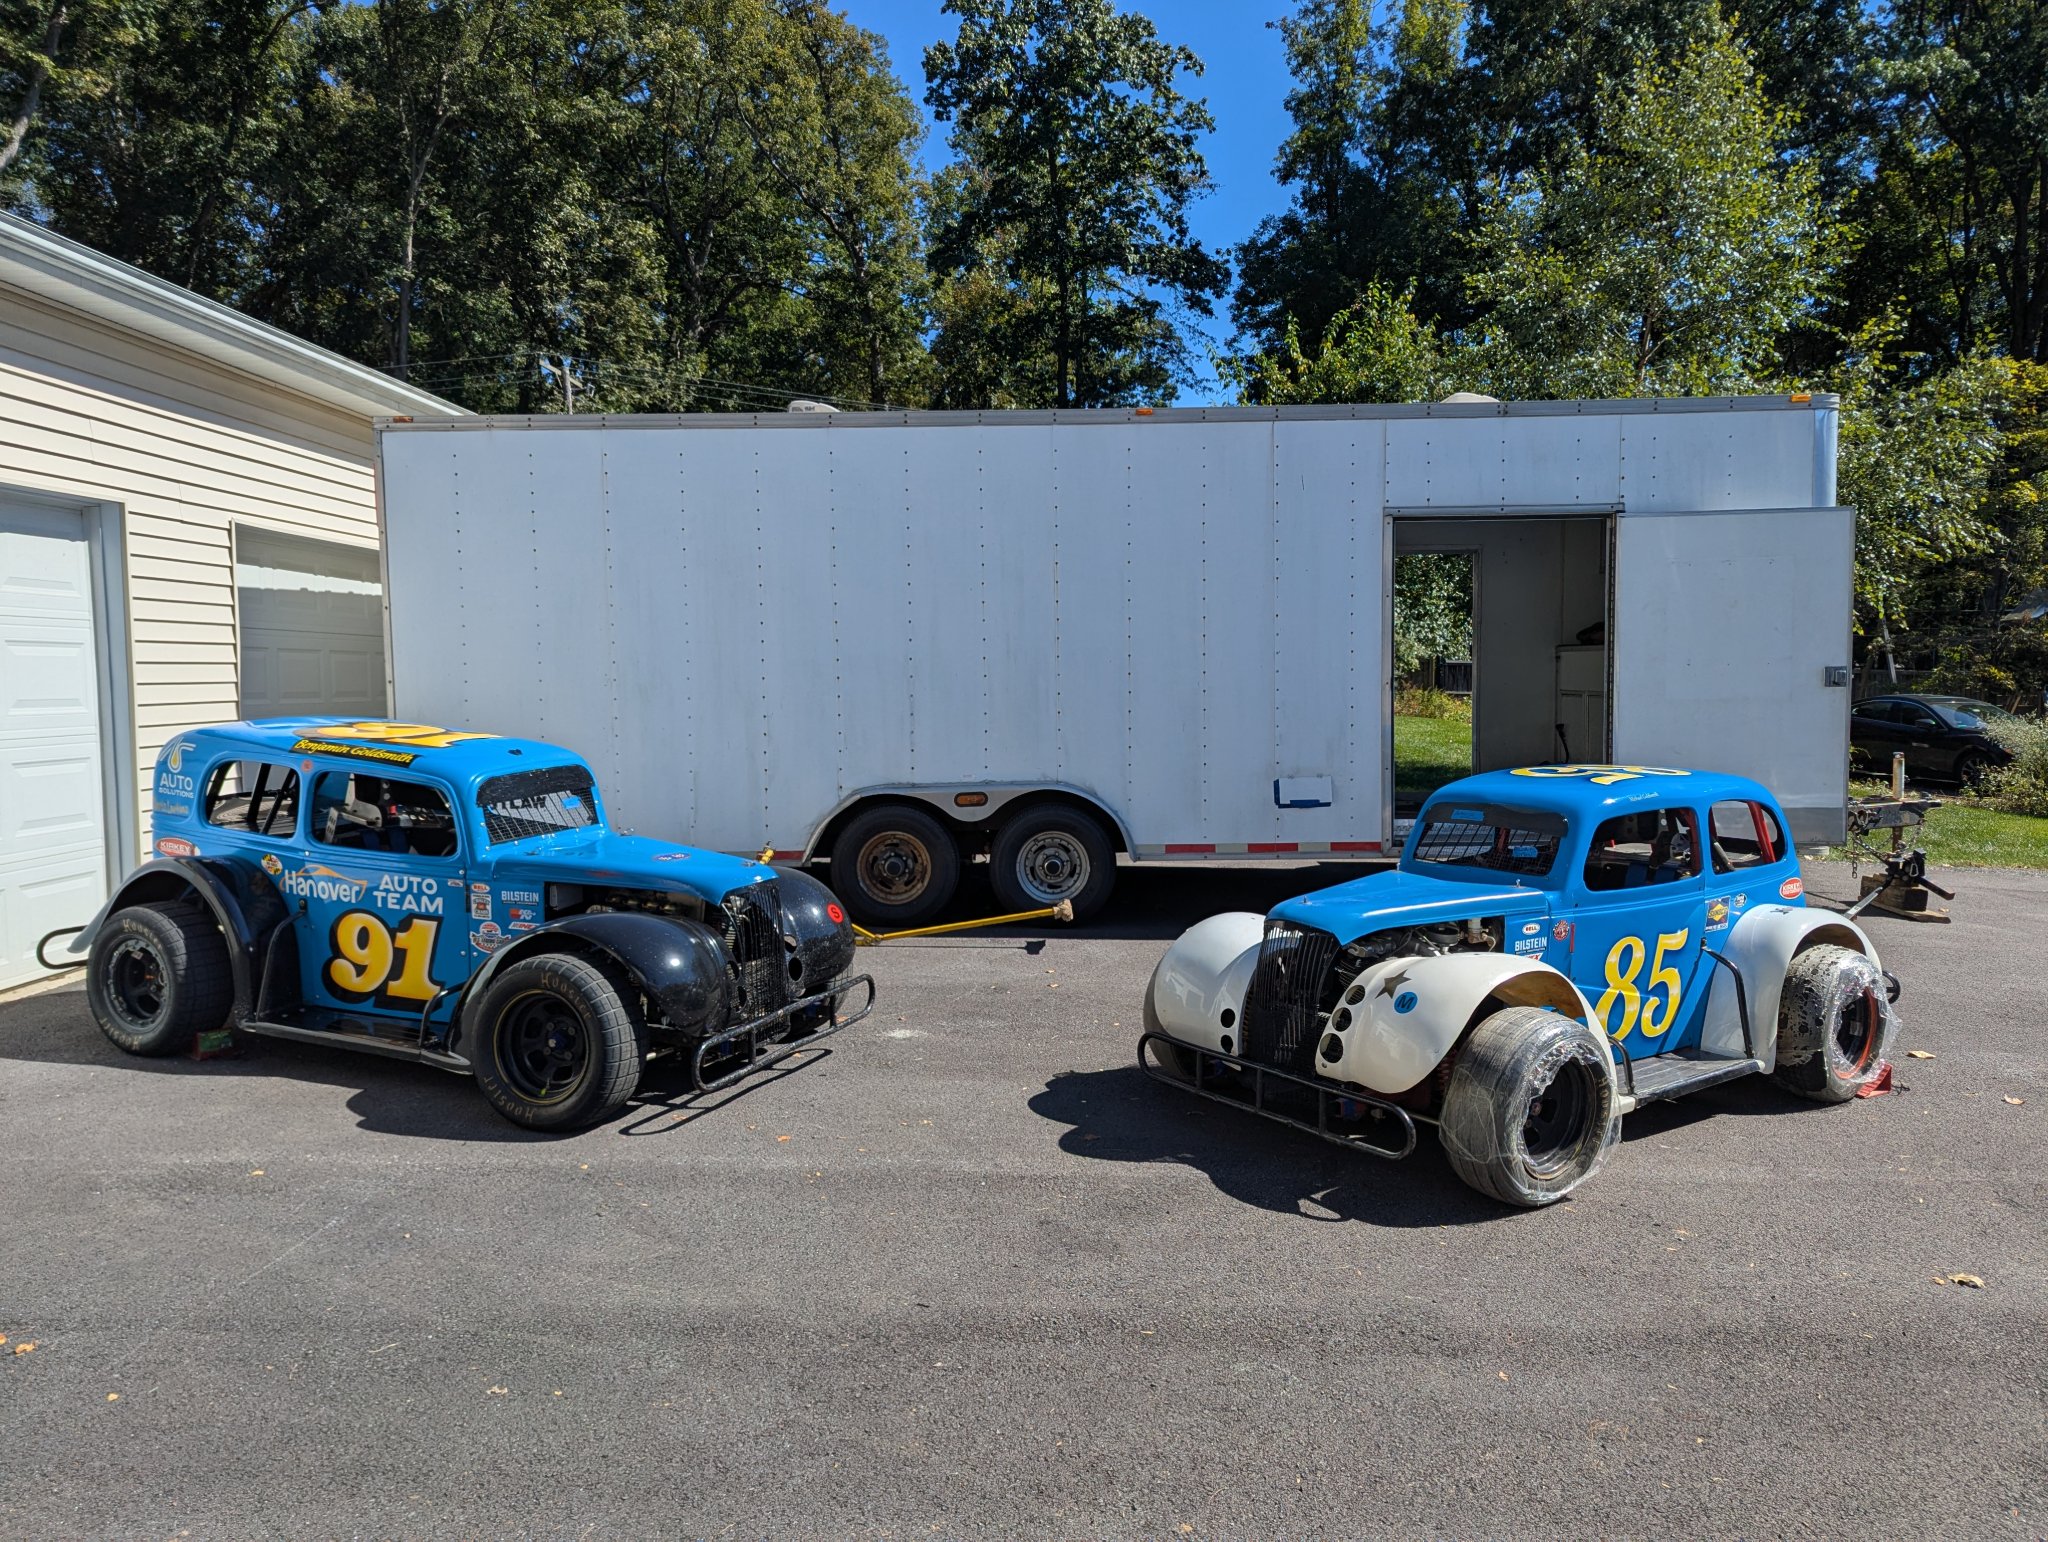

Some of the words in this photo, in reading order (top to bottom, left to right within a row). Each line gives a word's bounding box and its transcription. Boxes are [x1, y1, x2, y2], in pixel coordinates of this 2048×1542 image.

[294, 739, 350, 755] Benjamin
[350, 746, 416, 764] Goldsmith
[159, 772, 194, 791] AUTO
[158, 786, 195, 799] SOLUTIONS
[160, 840, 191, 853] KIRKEY
[284, 869, 361, 904] Hanover
[379, 874, 438, 895] AUTO
[473, 884, 488, 892] BELL
[372, 891, 444, 915] TEAM
[501, 890, 539, 902] BILSTEIN
[830, 906, 841, 919] S
[1514, 937, 1548, 952] BILSTEIN
[328, 911, 443, 1002] 91
[1594, 927, 1689, 1041] 85
[1397, 994, 1415, 1010] M
